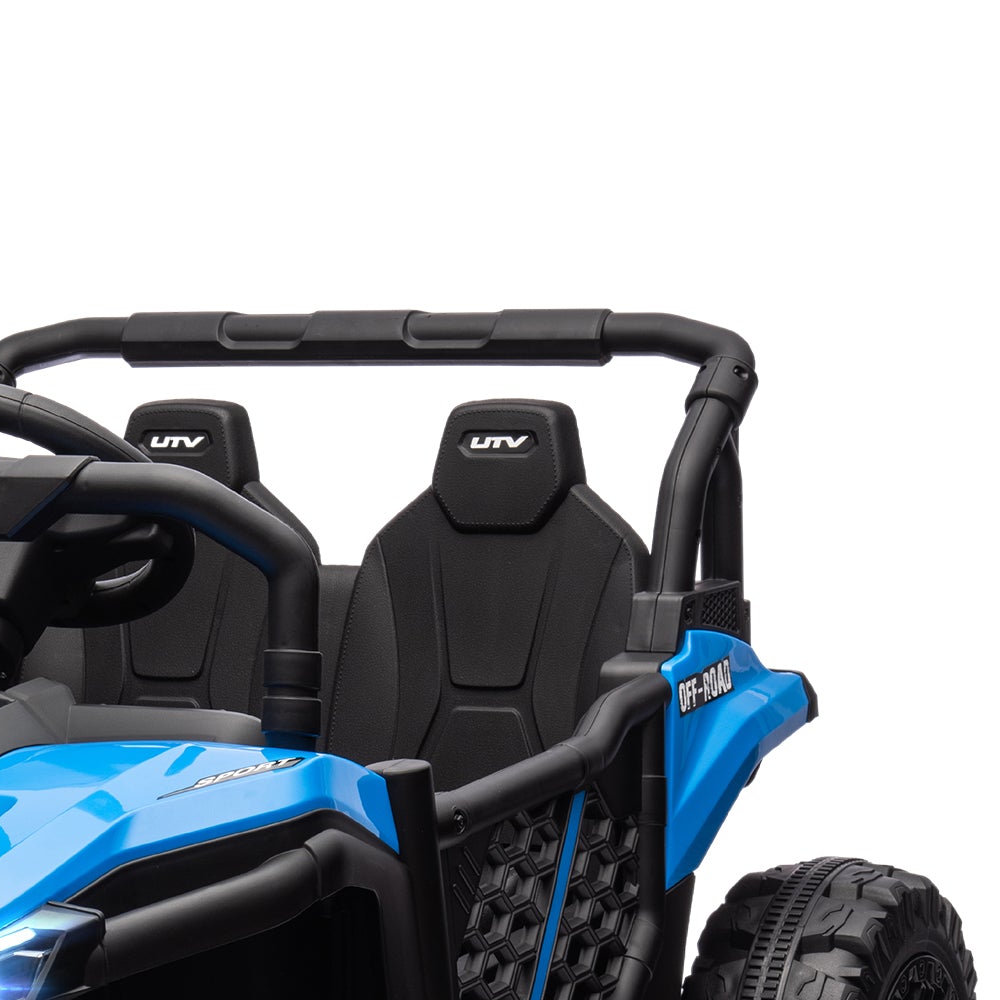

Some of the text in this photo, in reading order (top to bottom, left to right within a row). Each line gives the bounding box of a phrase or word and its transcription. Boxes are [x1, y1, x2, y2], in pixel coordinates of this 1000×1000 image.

[150, 436, 205, 448] UTV
[470, 435, 529, 449] UTV
[678, 659, 732, 713] OFF-ROAD
[193, 757, 298, 788] SPORT
